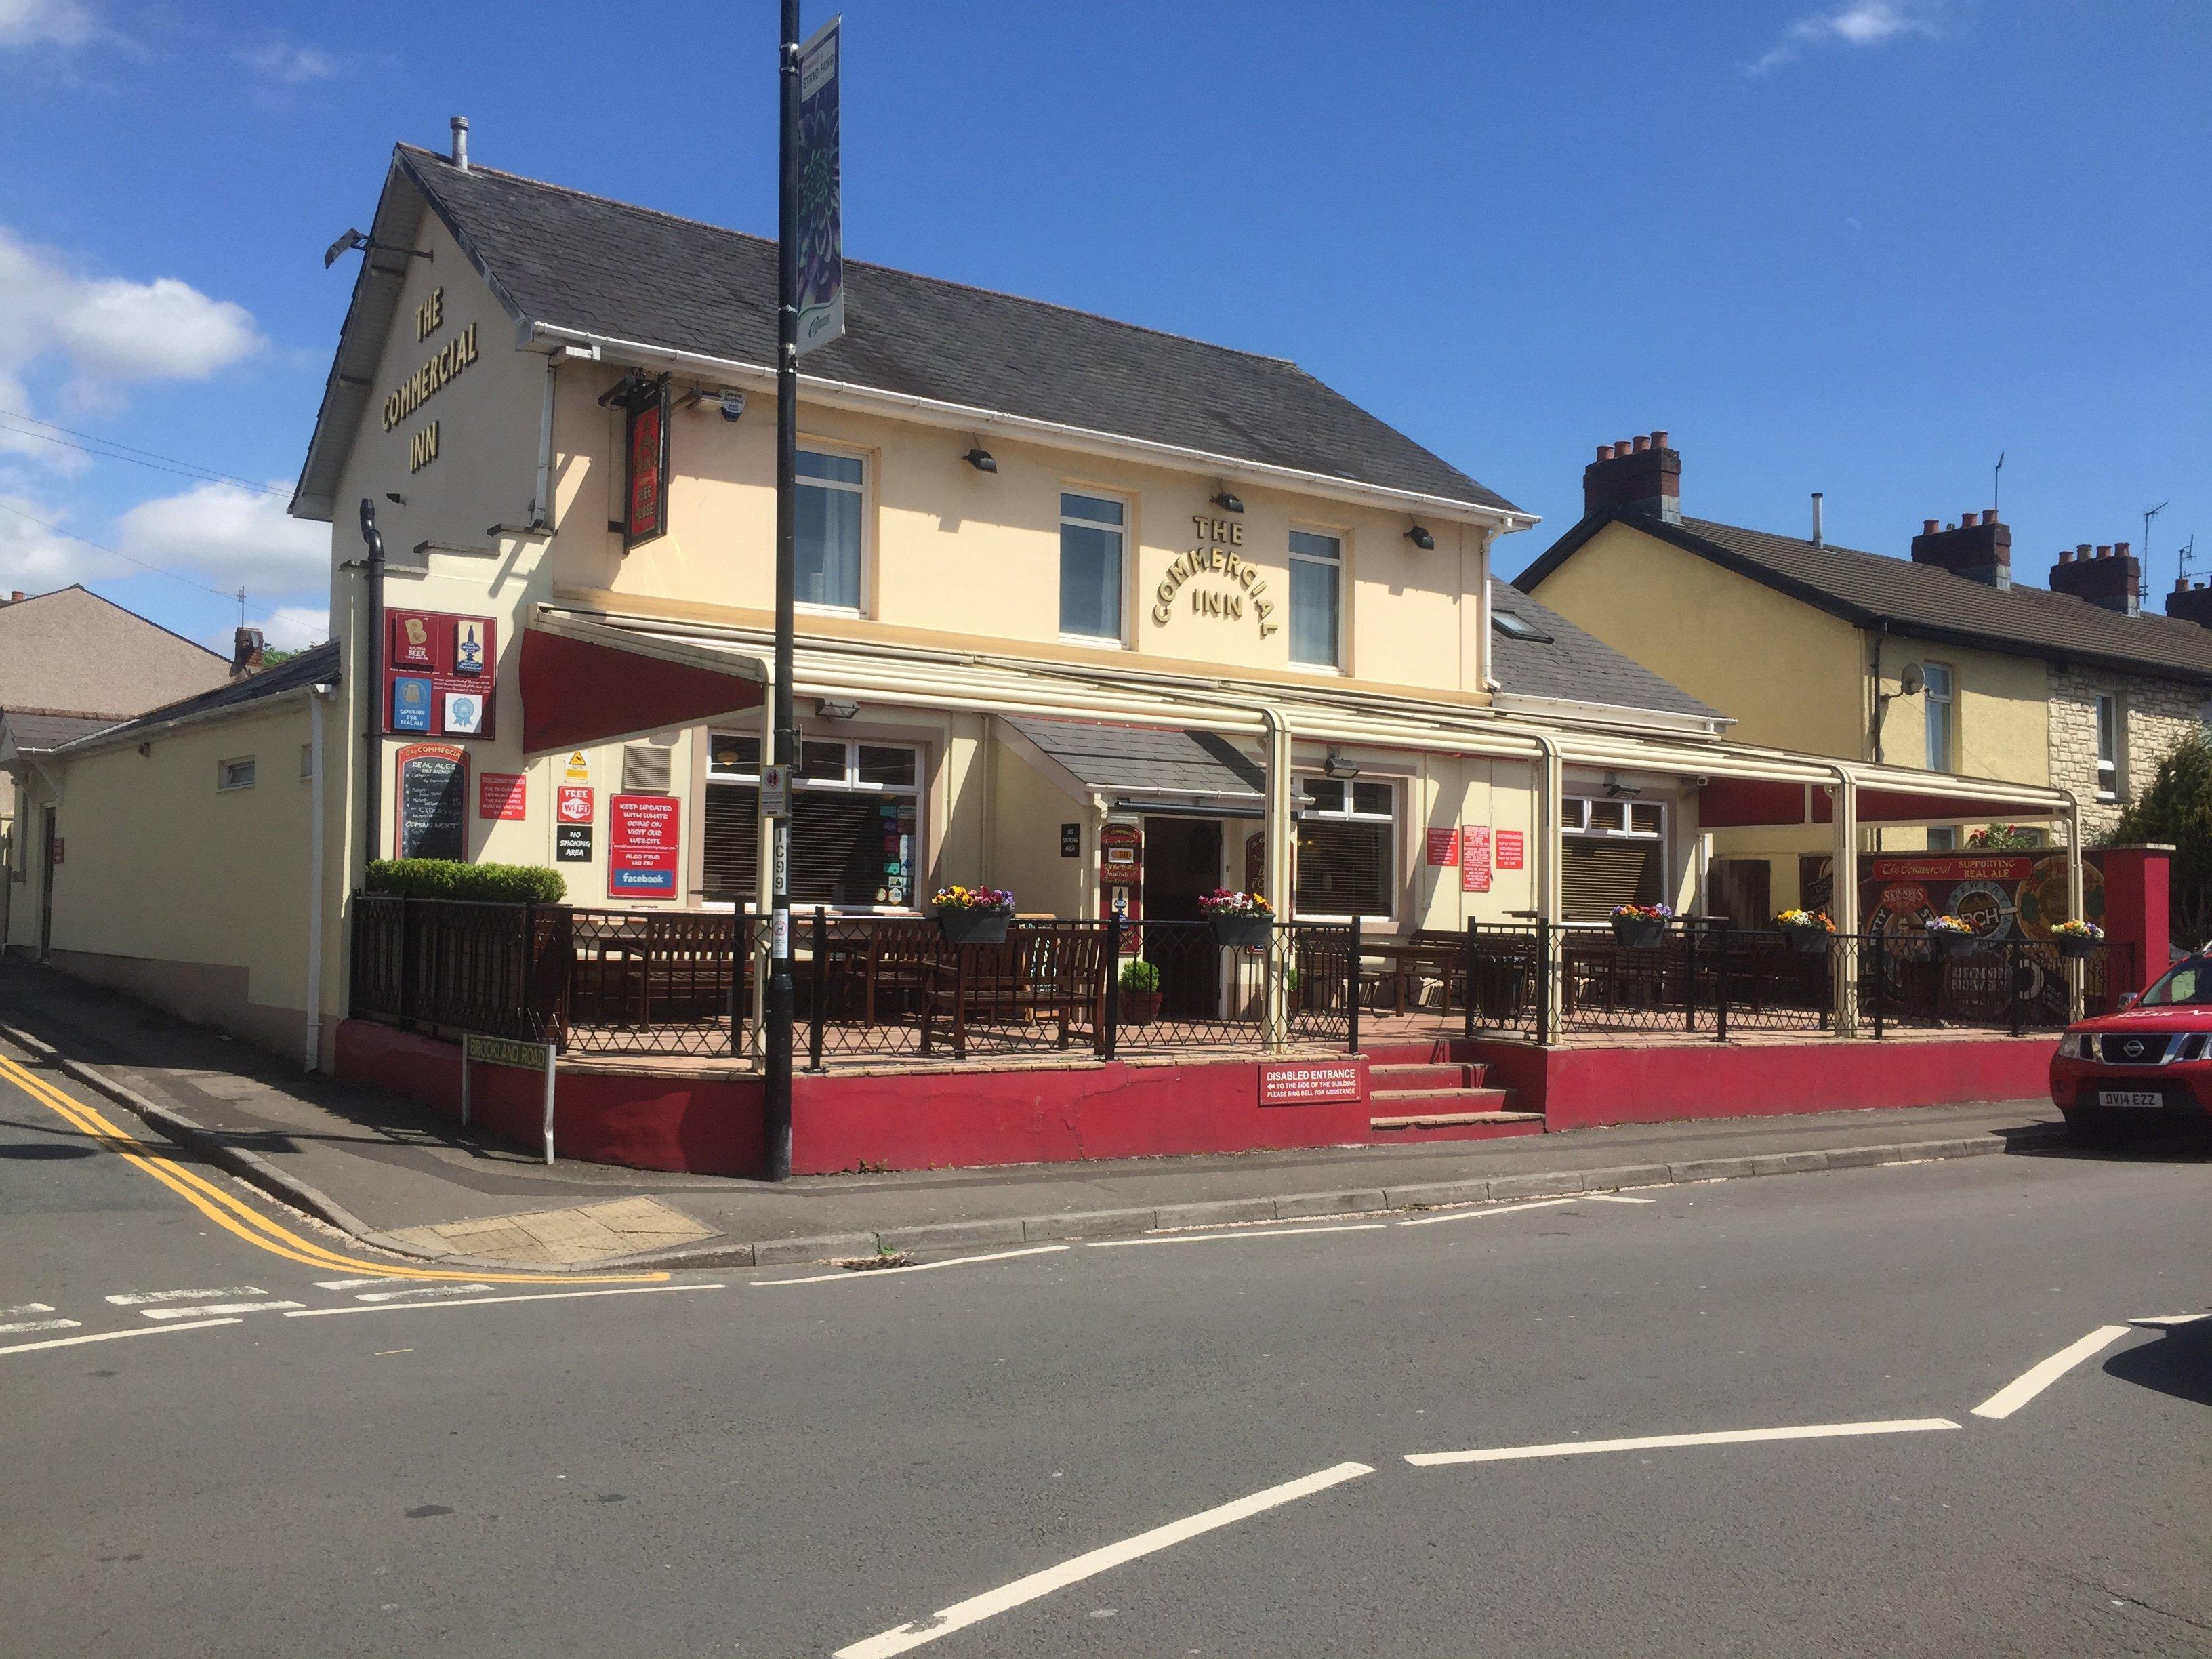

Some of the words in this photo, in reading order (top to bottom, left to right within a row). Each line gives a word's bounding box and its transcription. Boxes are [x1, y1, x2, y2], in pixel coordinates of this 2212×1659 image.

[415, 287, 441, 341] THE
[382, 321, 477, 430] COMMERCIAL
[410, 420, 438, 473] INN
[1193, 516, 1242, 545] THE
[1153, 547, 1278, 636] COMMERCIAL
[1193, 589, 1242, 617] INN
[417, 746, 462, 759] COMMERCIA
[565, 790, 588, 798] FREE
[1881, 863, 1900, 874] The
[1900, 862, 1952, 874] Commercial
[1959, 859, 2015, 868] SUPPORTING
[623, 872, 663, 883] facebook
[470, 1039, 518, 1063] BROOKLAND
[521, 1046, 545, 1066] ROAD
[1267, 1071, 1309, 1081] DISABLED
[1311, 1069, 1355, 1080] ENTRANCE
[2106, 1093, 2129, 1105] DV14
[2134, 1094, 2155, 1105] EZZ
